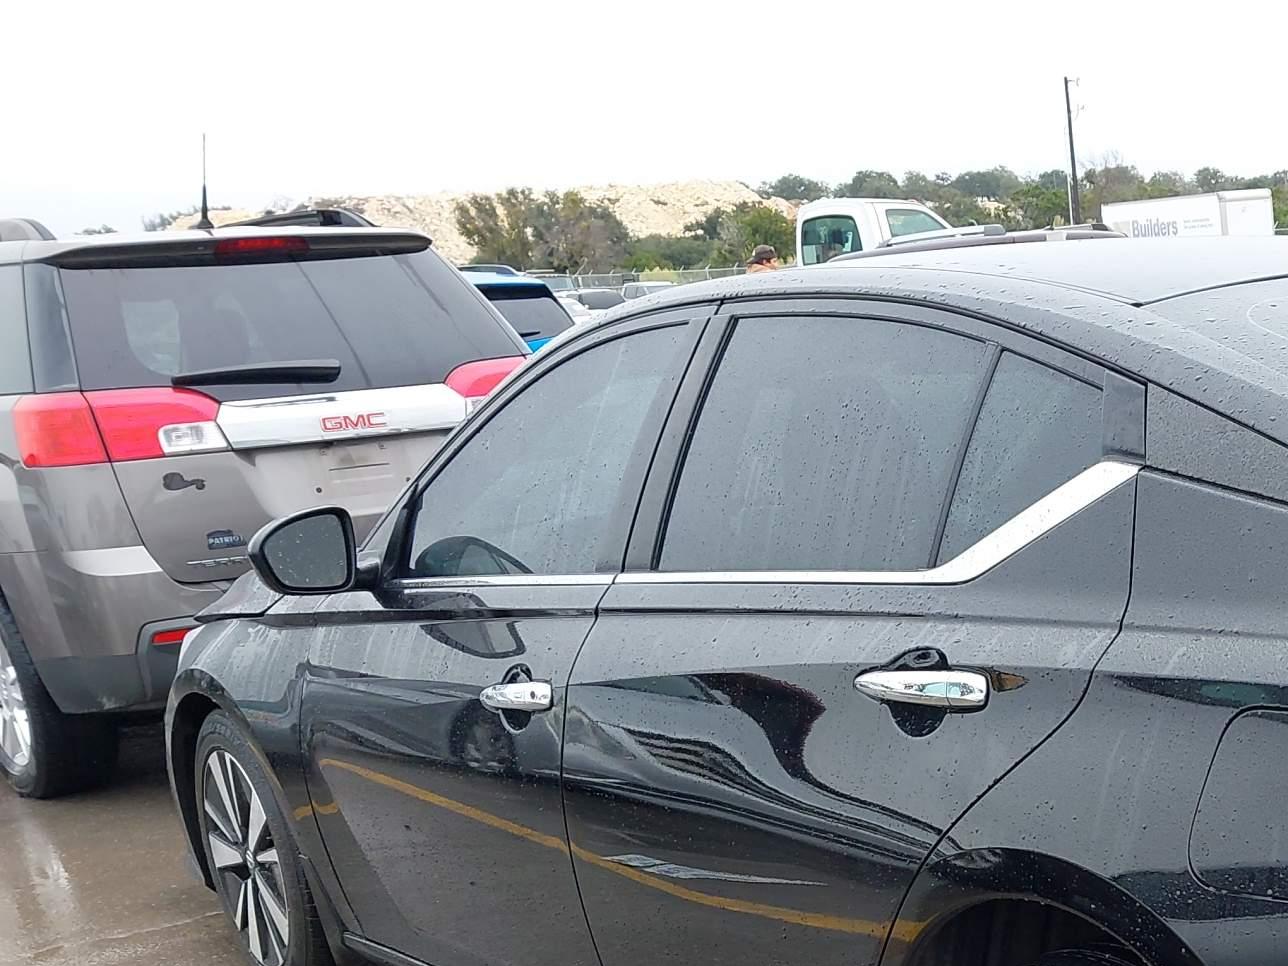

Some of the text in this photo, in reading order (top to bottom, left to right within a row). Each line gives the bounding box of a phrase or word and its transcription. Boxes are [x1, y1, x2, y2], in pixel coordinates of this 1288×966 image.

[1132, 217, 1178, 238] Builders
[320, 411, 388, 433] GMC
[208, 535, 244, 545] PATRIO
